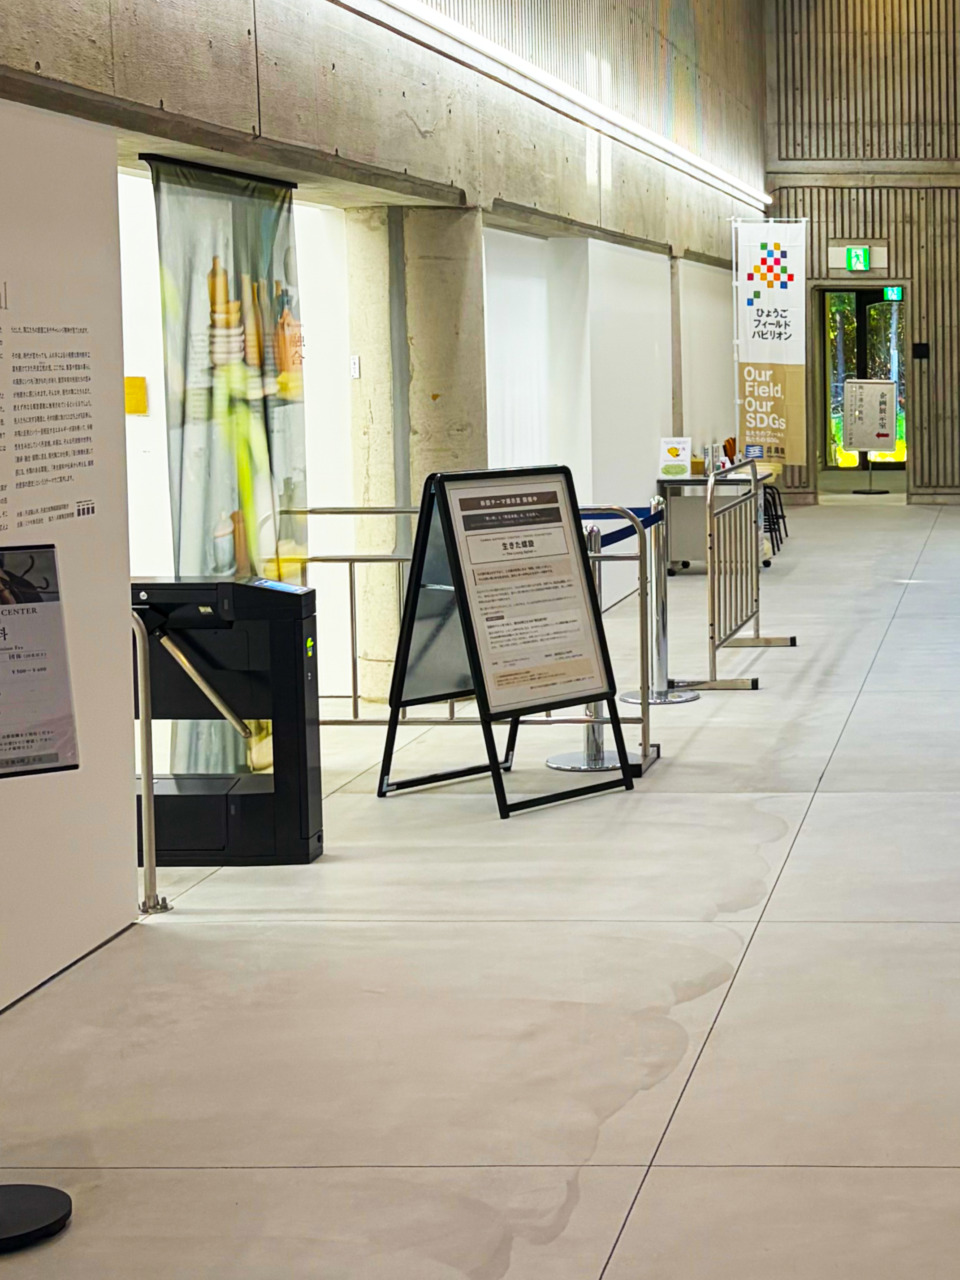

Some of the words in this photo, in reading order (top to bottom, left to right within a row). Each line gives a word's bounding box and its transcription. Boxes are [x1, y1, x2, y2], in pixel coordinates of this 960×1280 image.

[756, 308, 789, 318] ひょうご
[753, 319, 791, 330] フィールド
[752, 330, 792, 341] パビリオン
[744, 366, 773, 382] Our
[745, 382, 784, 400] Field,
[744, 397, 774, 412] Our
[745, 413, 786, 430] SDGs
[1, 607, 38, 616] CENTER
